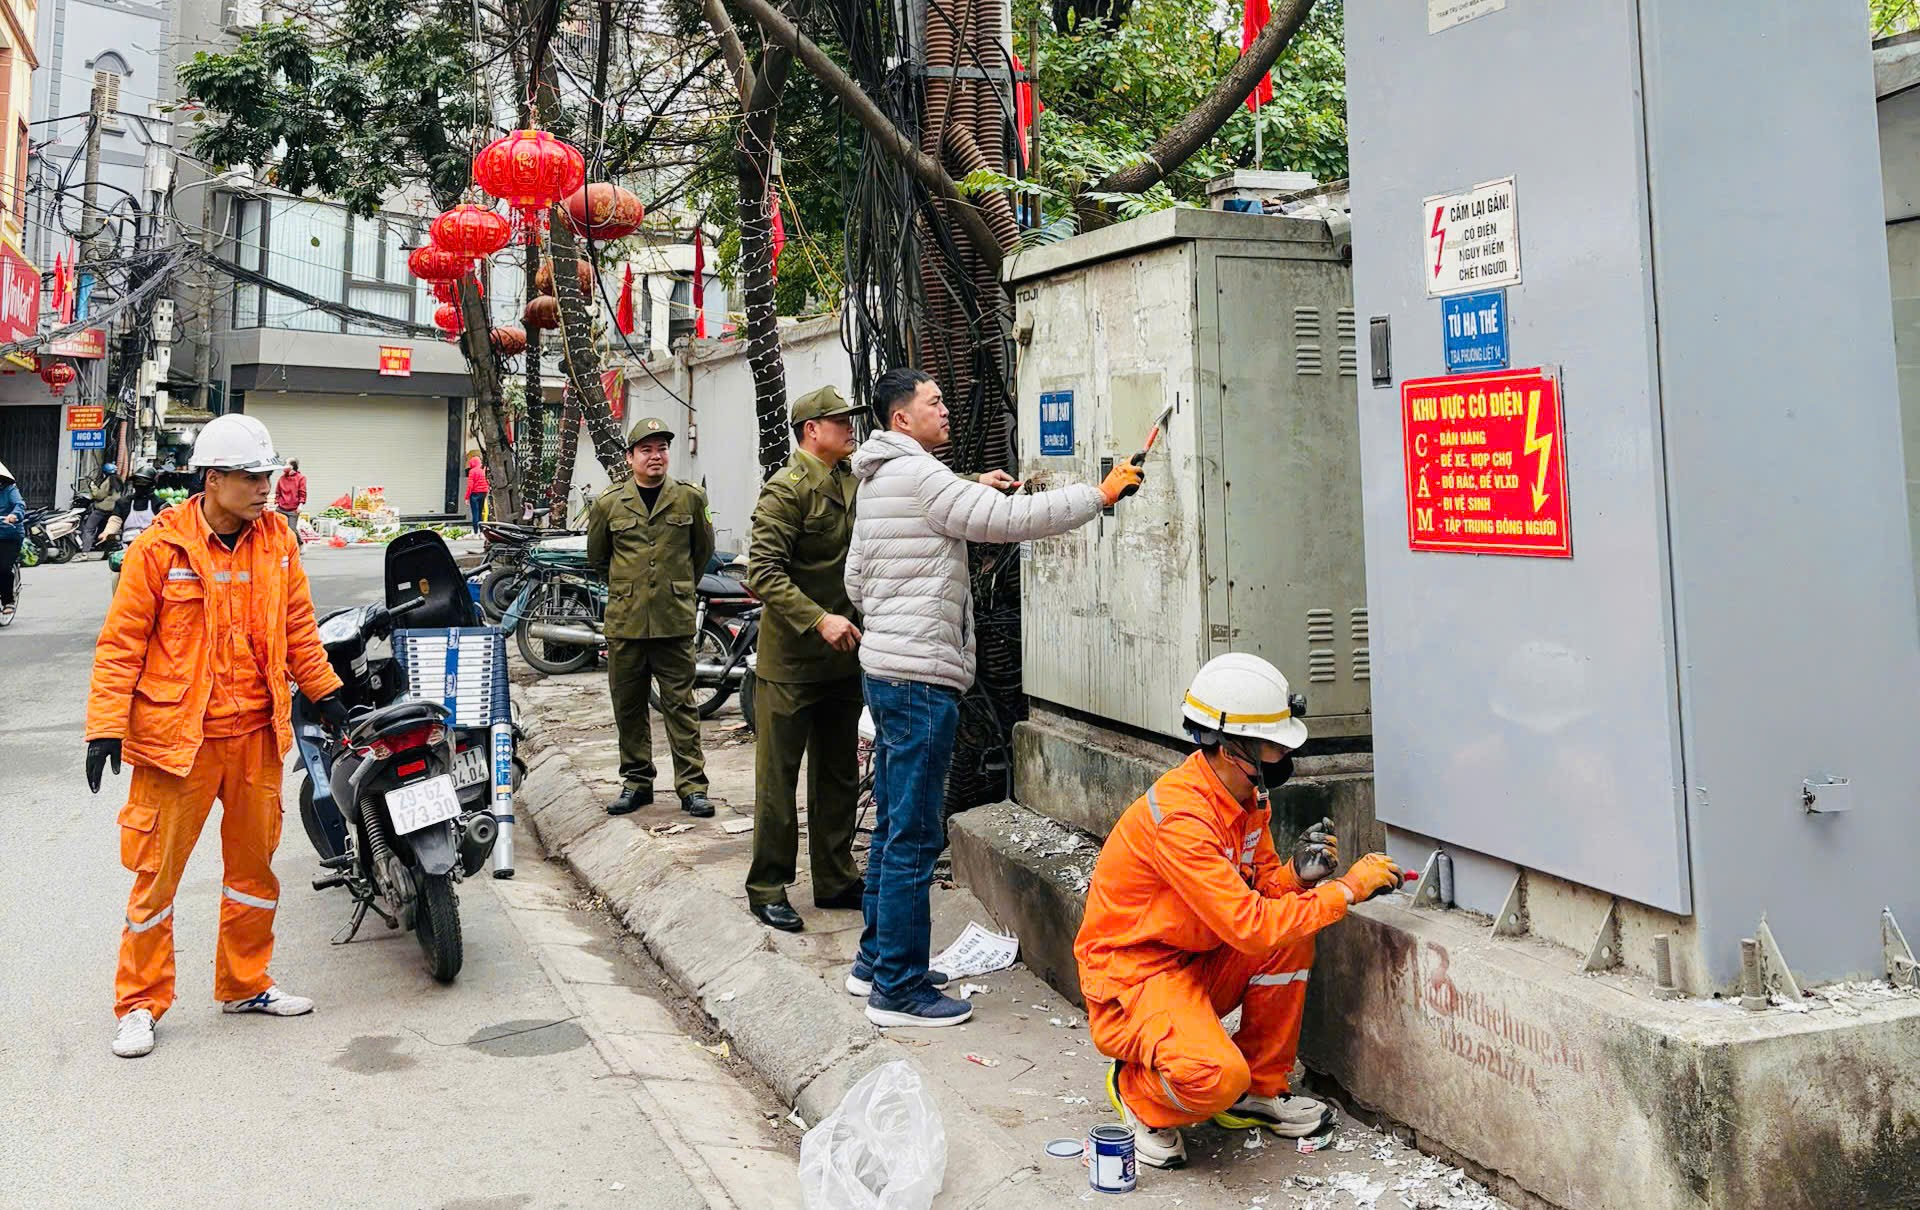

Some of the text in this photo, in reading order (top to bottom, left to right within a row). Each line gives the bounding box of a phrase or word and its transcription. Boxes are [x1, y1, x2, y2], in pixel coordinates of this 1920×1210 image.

[1450, 190, 1510, 222] CẤM LẠI GẦN!
[1464, 221, 1497, 241] CÓ ĐIỆN
[1459, 239, 1504, 262] NGUY HIỂM
[1459, 258, 1508, 281] CHẾT NGƯỜI
[1016, 288, 1038, 304] TOJI
[1448, 302, 1499, 340] TỦ HẠ THẾ
[1412, 386, 1523, 424] KHU VỰC CÓ ĐIỆN
[92, 431, 102, 441] 30
[1460, 430, 1486, 446] HÀNG
[1440, 450, 1452, 467] ĐỂ
[1471, 453, 1490, 470] HỌP
[1492, 450, 1512, 468] CHỢ
[1494, 474, 1519, 489] VLXD
[1443, 494, 1491, 513] ĐI VỆ SINH
[1443, 515, 1557, 536] TẬP TRUNG ĐÔNG NGƯỜI
[398, 797, 455, 830] 173.30
